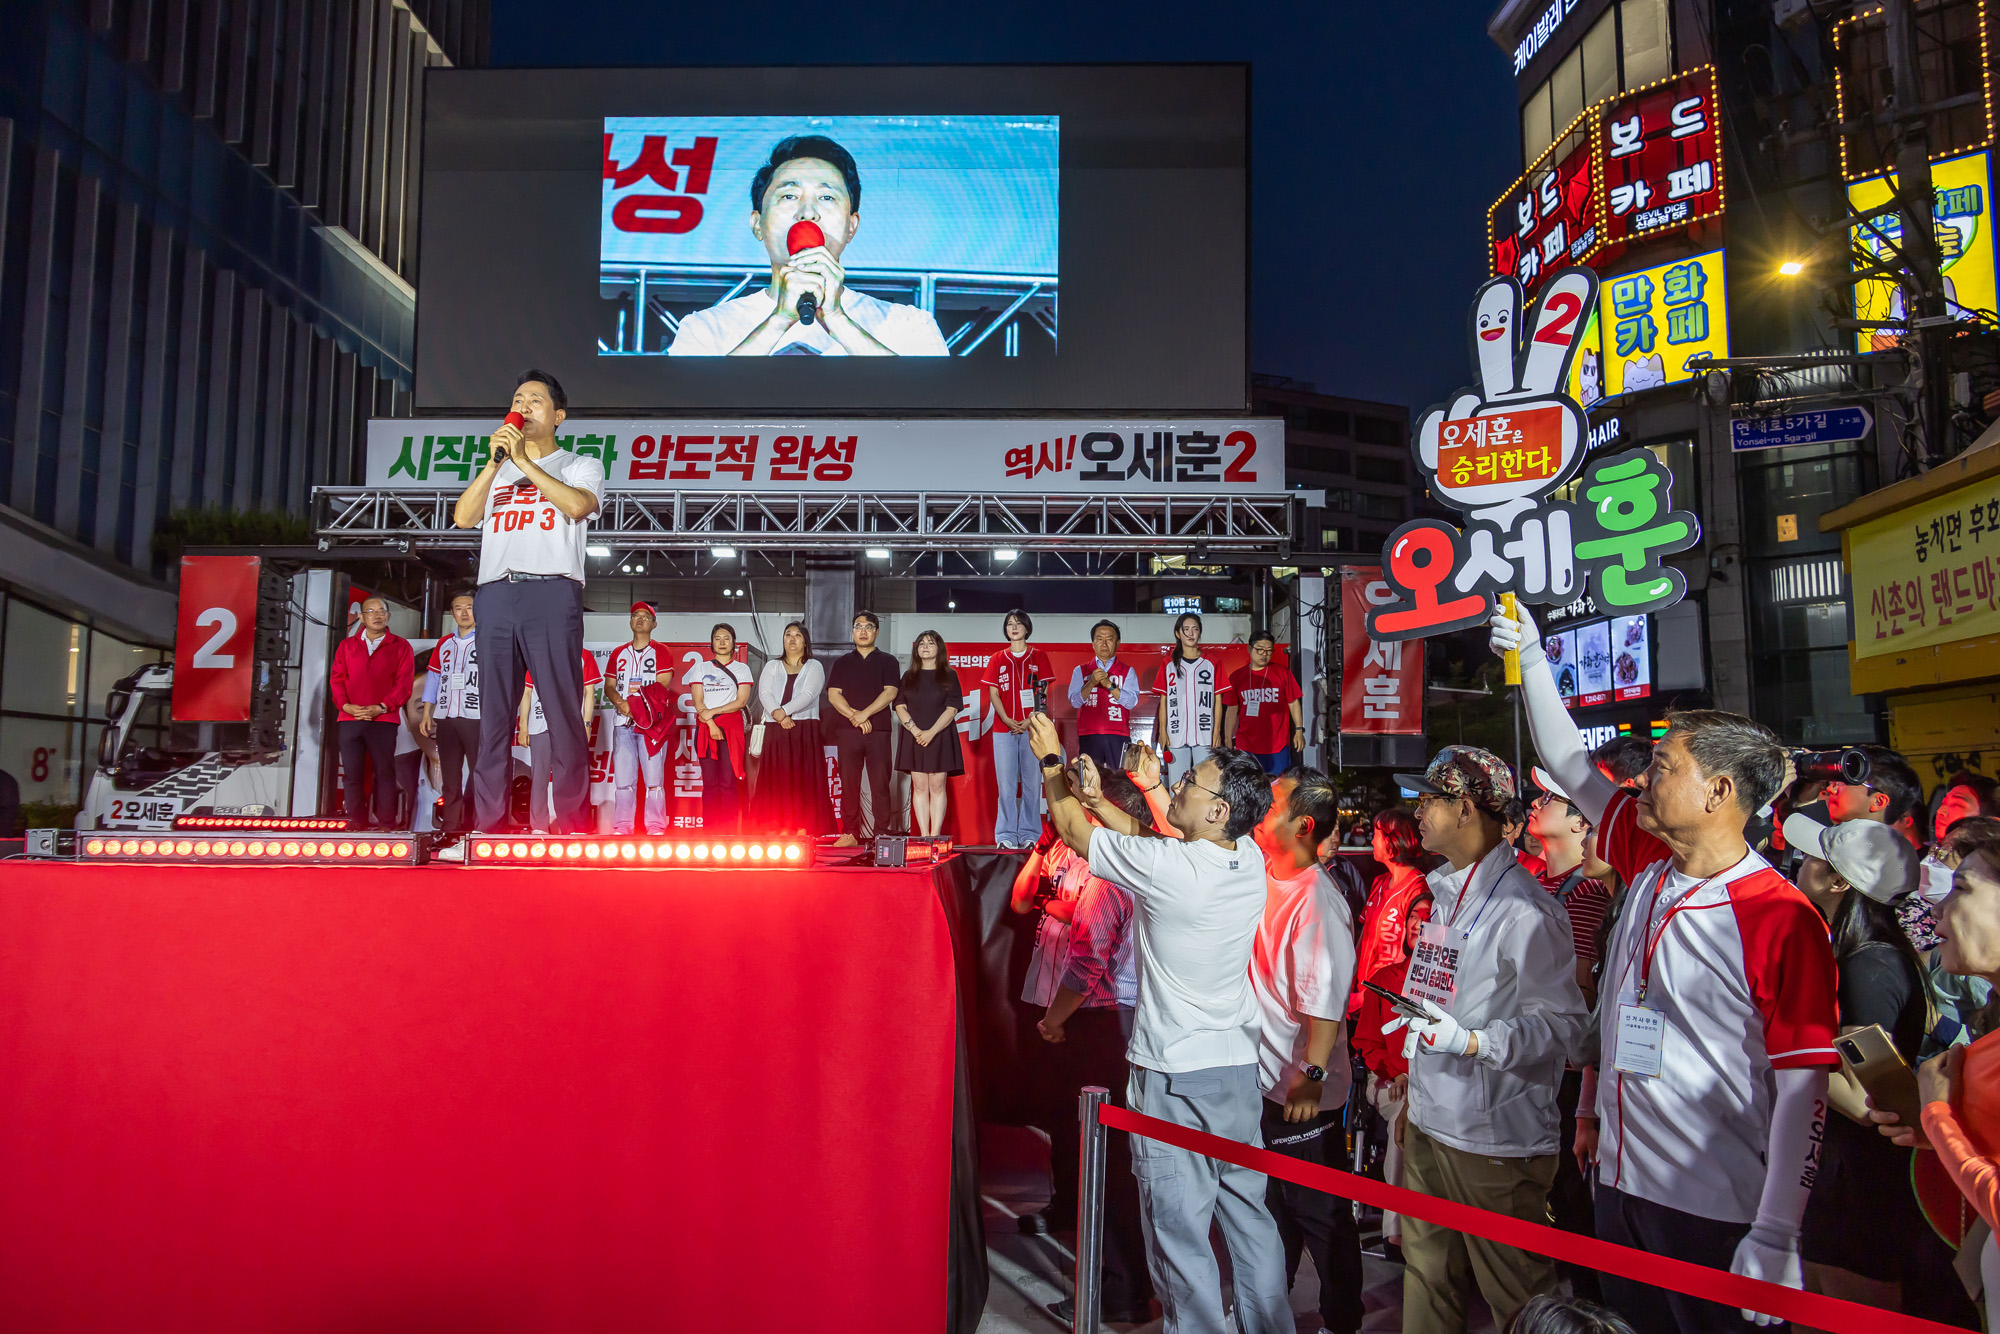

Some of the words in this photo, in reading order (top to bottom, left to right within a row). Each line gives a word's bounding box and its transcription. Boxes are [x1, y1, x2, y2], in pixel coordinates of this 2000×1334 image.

[1611, 97, 1705, 157] 보드
[604, 133, 719, 234] 성
[1611, 160, 1712, 215] 카페
[1636, 209, 1662, 223] DEVIL
[1664, 202, 1687, 213] DICE
[1519, 222, 1565, 285] 카페
[1613, 263, 1705, 317] 만화
[1534, 292, 1582, 346] 2
[1617, 303, 1706, 355] 카페
[1439, 417, 1523, 450] 오세훈은
[1589, 417, 1620, 450] HAIR
[1737, 437, 1782, 447] Yonsei-ro
[1784, 432, 1817, 443] 5ga-gil
[556, 434, 618, 480] 화
[629, 435, 759, 481] 압도적
[770, 435, 858, 481] 완성
[1005, 435, 1077, 479] 역시!
[1451, 446, 1558, 485] 승리한다.
[492, 510, 535, 533] TOP
[540, 508, 555, 530] 3
[1915, 510, 1962, 563] 놓치면
[1375, 458, 1688, 634] 오세훈
[1871, 576, 1926, 639] 신촌의
[1930, 556, 2000, 626] 랜드마
[192, 607, 238, 669] 2
[443, 650, 451, 663] 2
[618, 659, 626, 671] 2
[682, 651, 704, 685] 2
[1168, 672, 1176, 687] 2
[1169, 687, 1180, 729] 서울시장
[1198, 670, 1212, 731] 오세훈
[1389, 908, 1398, 922] 2
[1377, 920, 1402, 968] 강민
[1625, 1014, 1658, 1026] 선거사무원
[1271, 1134, 1302, 1145] LIFEWORK
